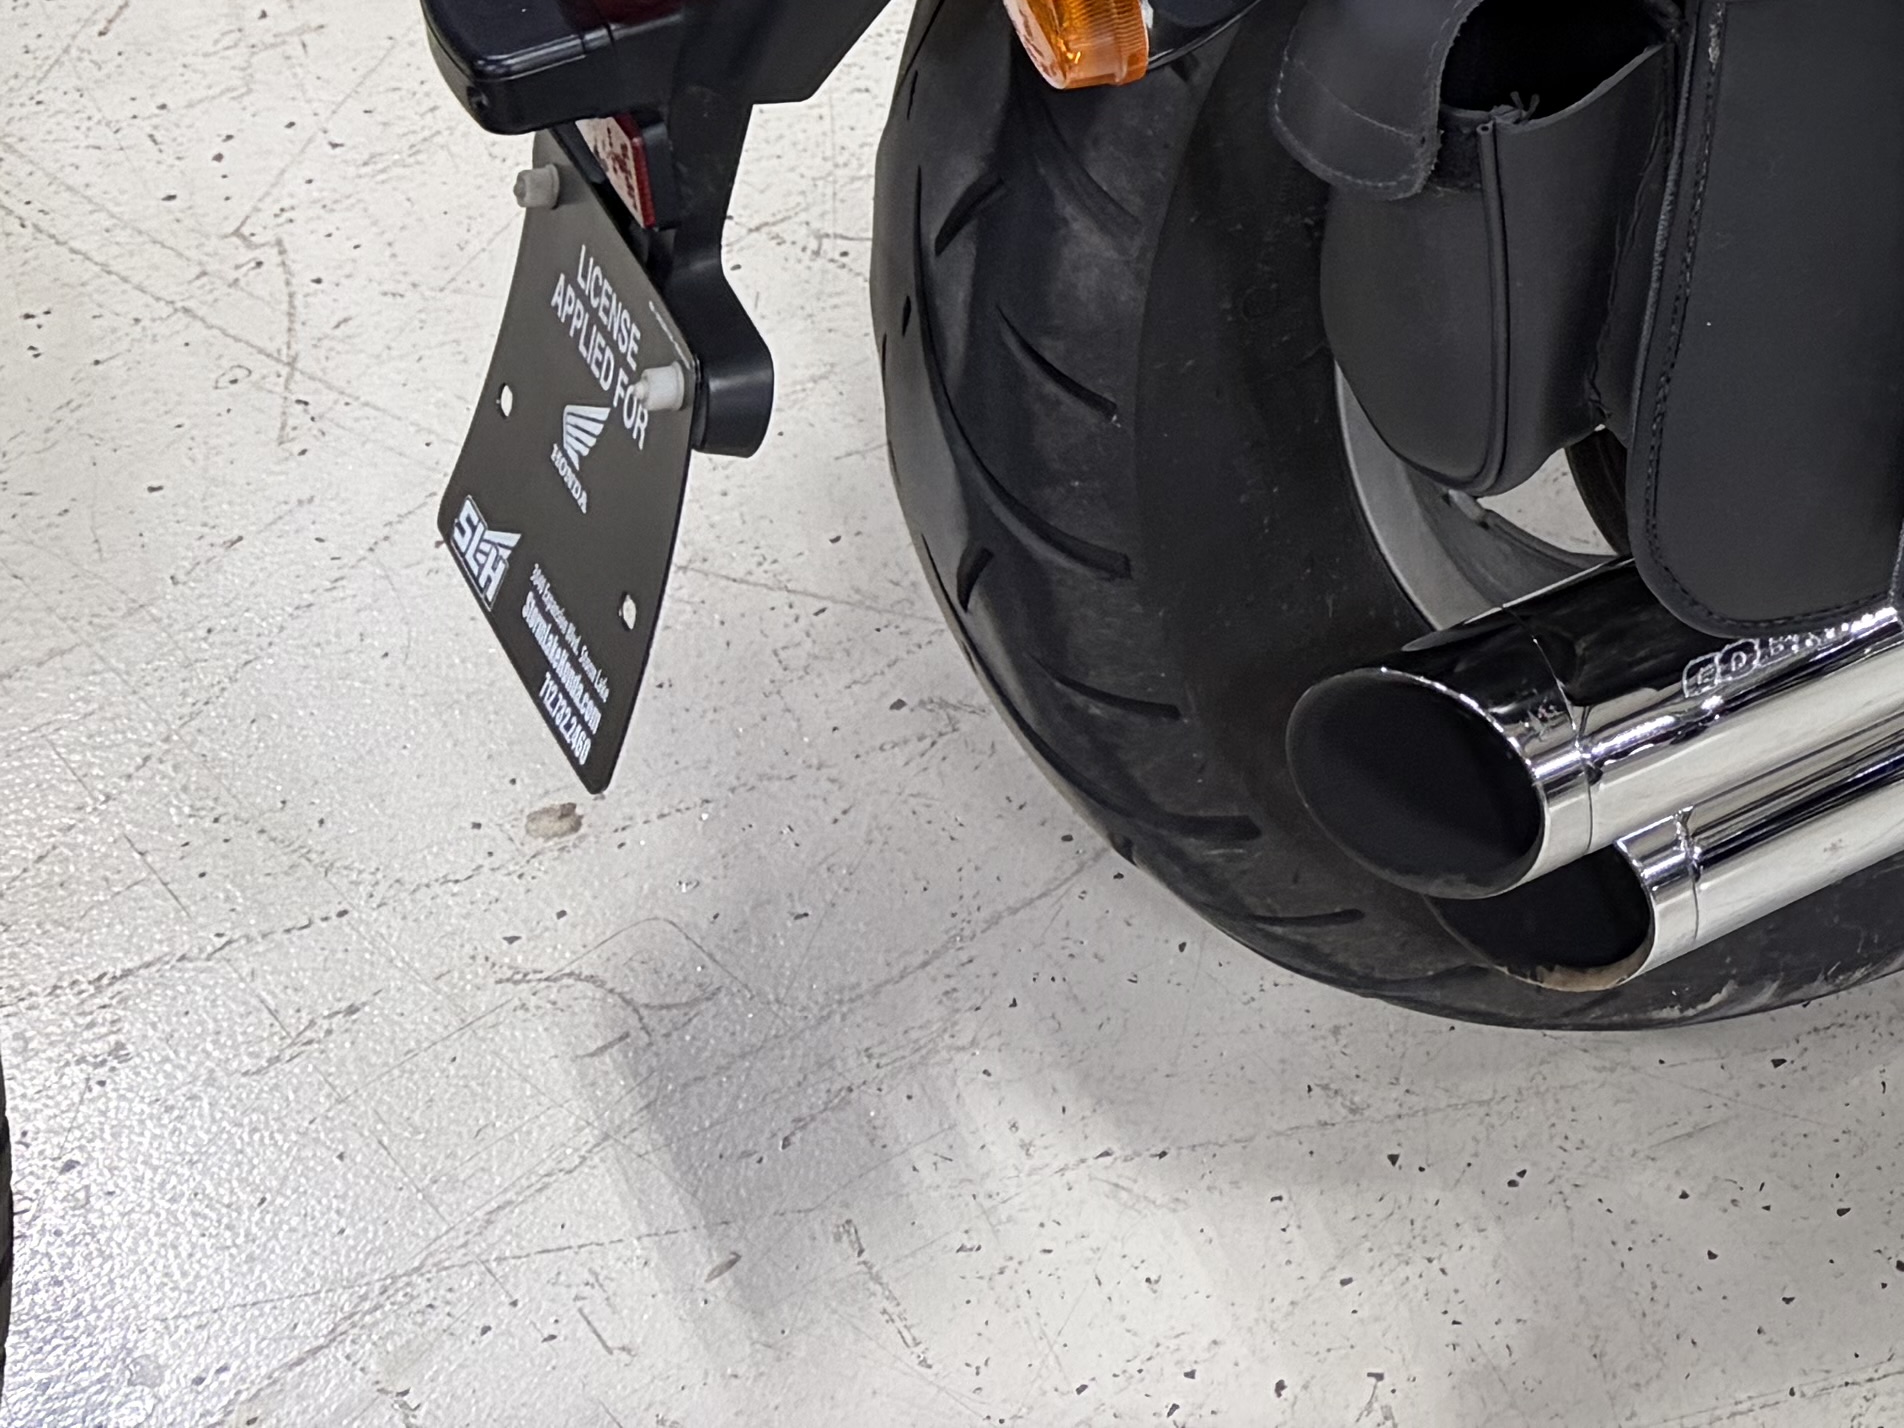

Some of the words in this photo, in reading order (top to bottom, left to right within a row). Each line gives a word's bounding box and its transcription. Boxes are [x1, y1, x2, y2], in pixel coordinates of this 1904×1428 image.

[551, 272, 615, 391] APPLIED
[612, 367, 649, 450] FOR
[576, 244, 641, 371] LICENSE
[550, 443, 588, 514] HONDA
